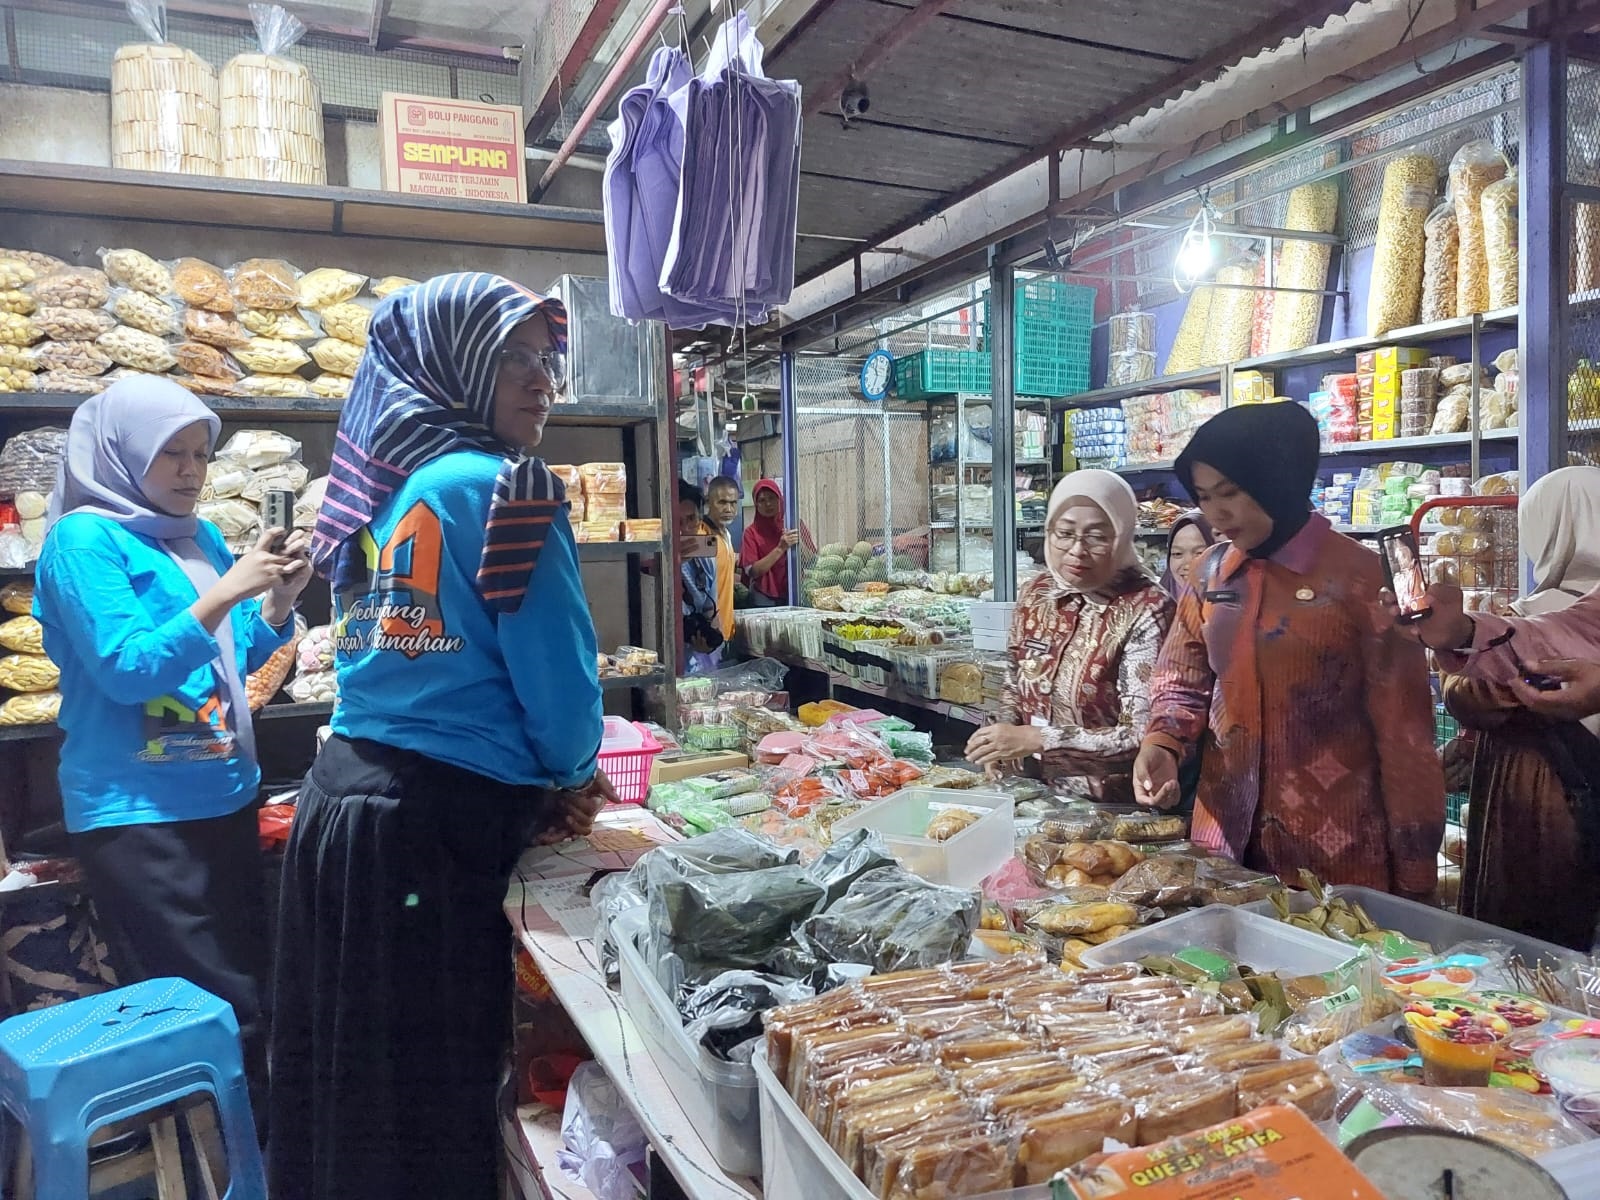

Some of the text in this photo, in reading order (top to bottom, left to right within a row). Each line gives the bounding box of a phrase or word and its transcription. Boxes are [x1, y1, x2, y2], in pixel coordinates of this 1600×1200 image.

[428, 110, 499, 126] BOLU PANGGANG
[403, 141, 508, 170] SEMPURNA
[419, 171, 500, 187] KWALITET TERJAMIN
[409, 183, 457, 196] MAGELANG
[465, 188, 510, 200] INDONESIA
[1130, 1151, 1205, 1186] QUEEN
